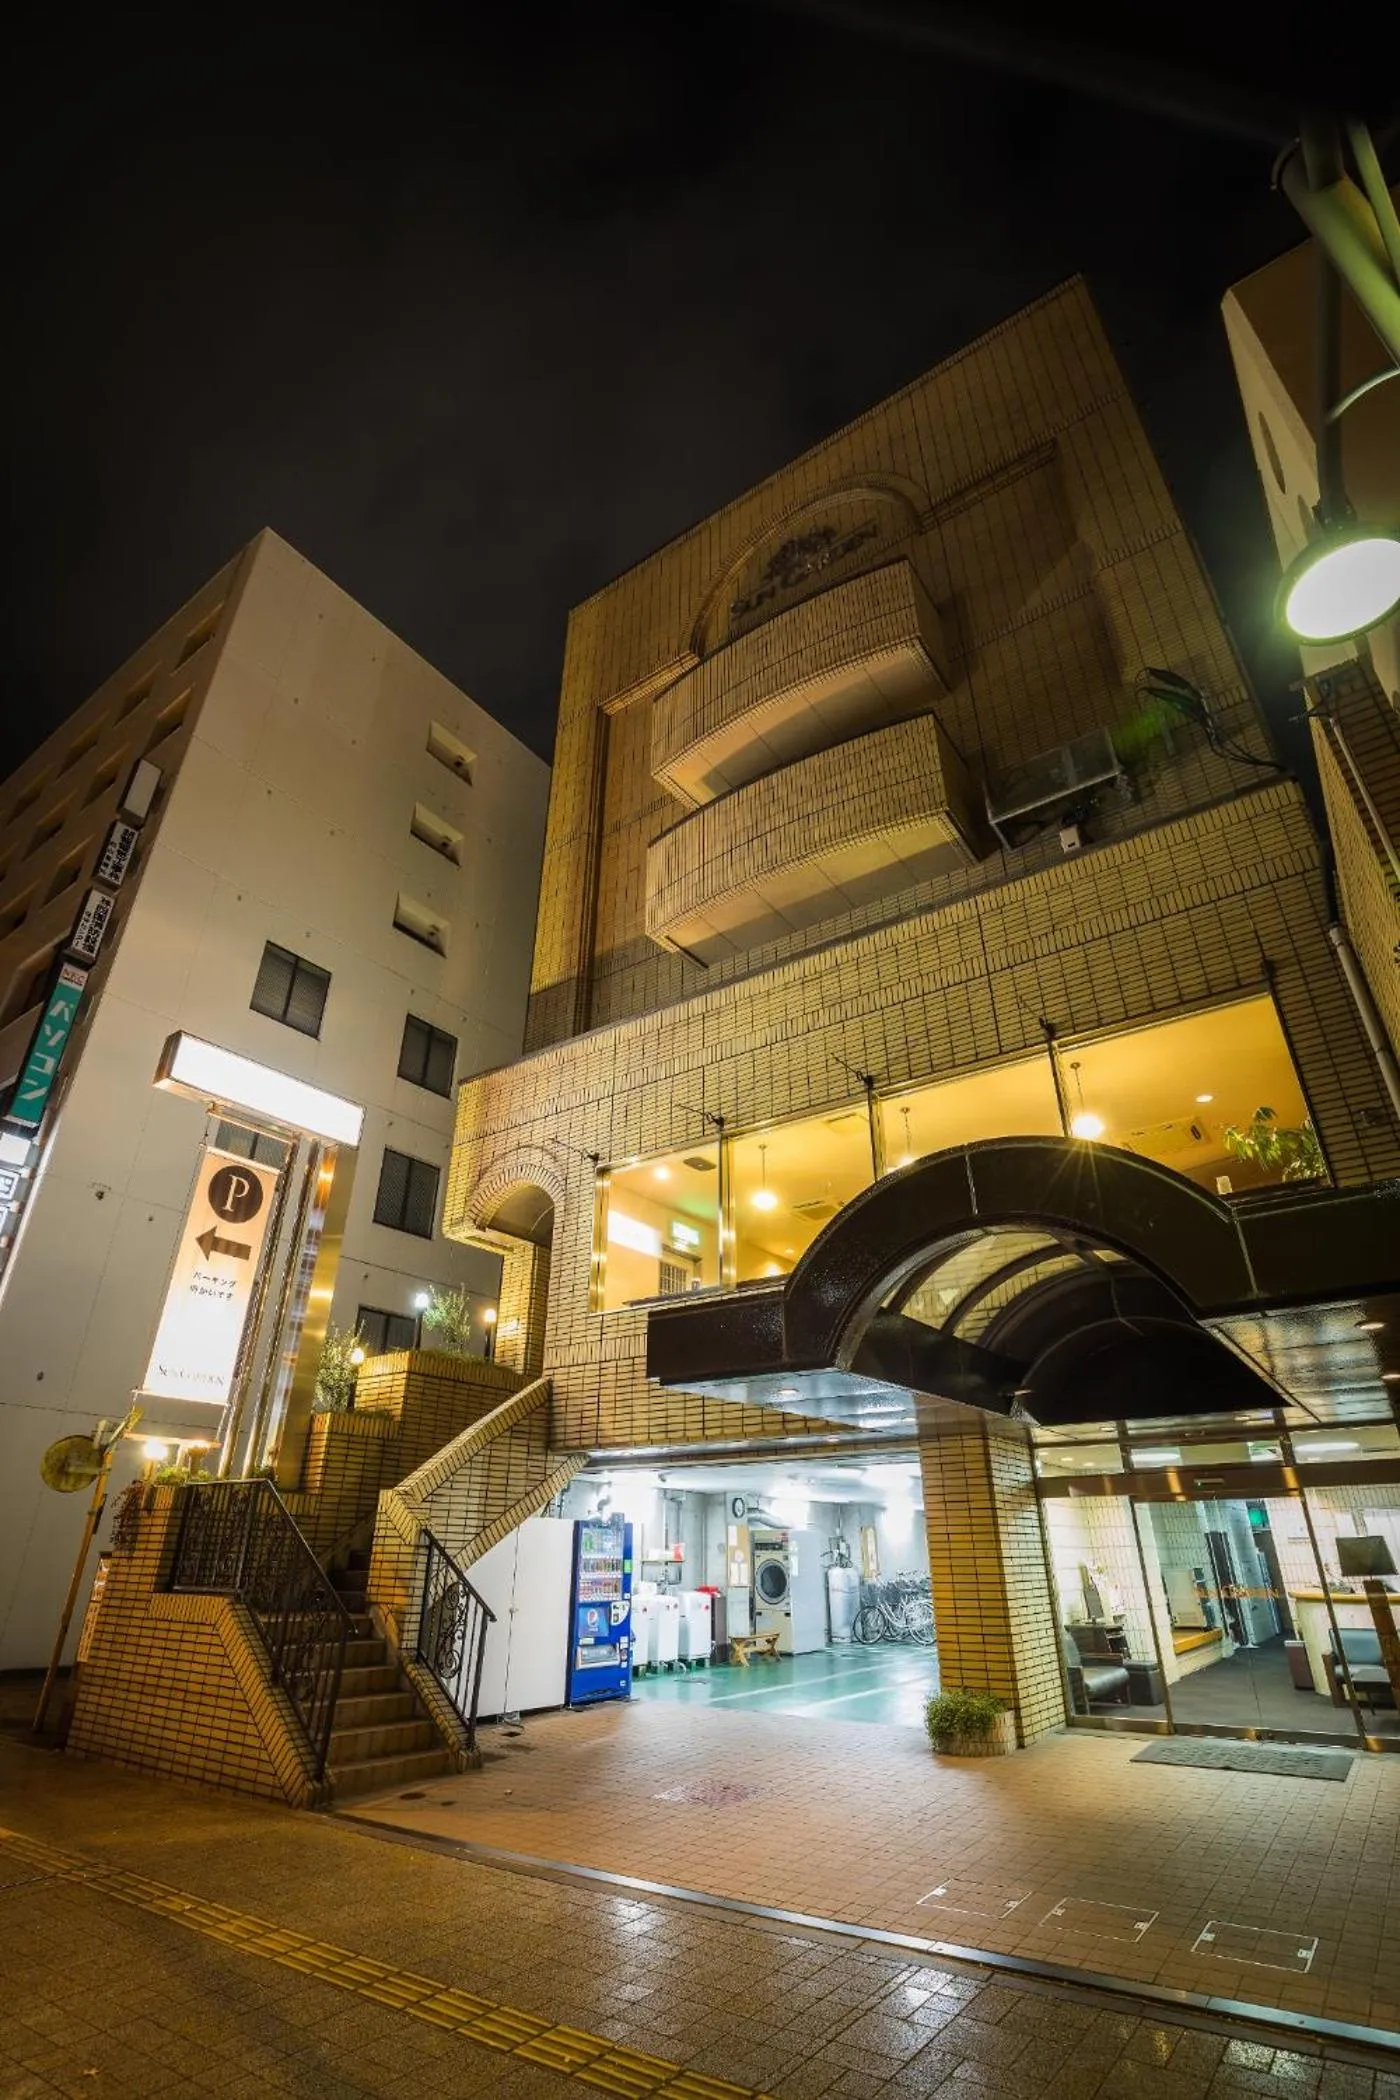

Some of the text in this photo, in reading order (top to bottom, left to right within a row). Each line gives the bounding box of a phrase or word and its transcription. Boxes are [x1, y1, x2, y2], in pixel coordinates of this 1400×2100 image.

[20, 998, 75, 1101] パソコン
[221, 1173, 251, 1212] P
